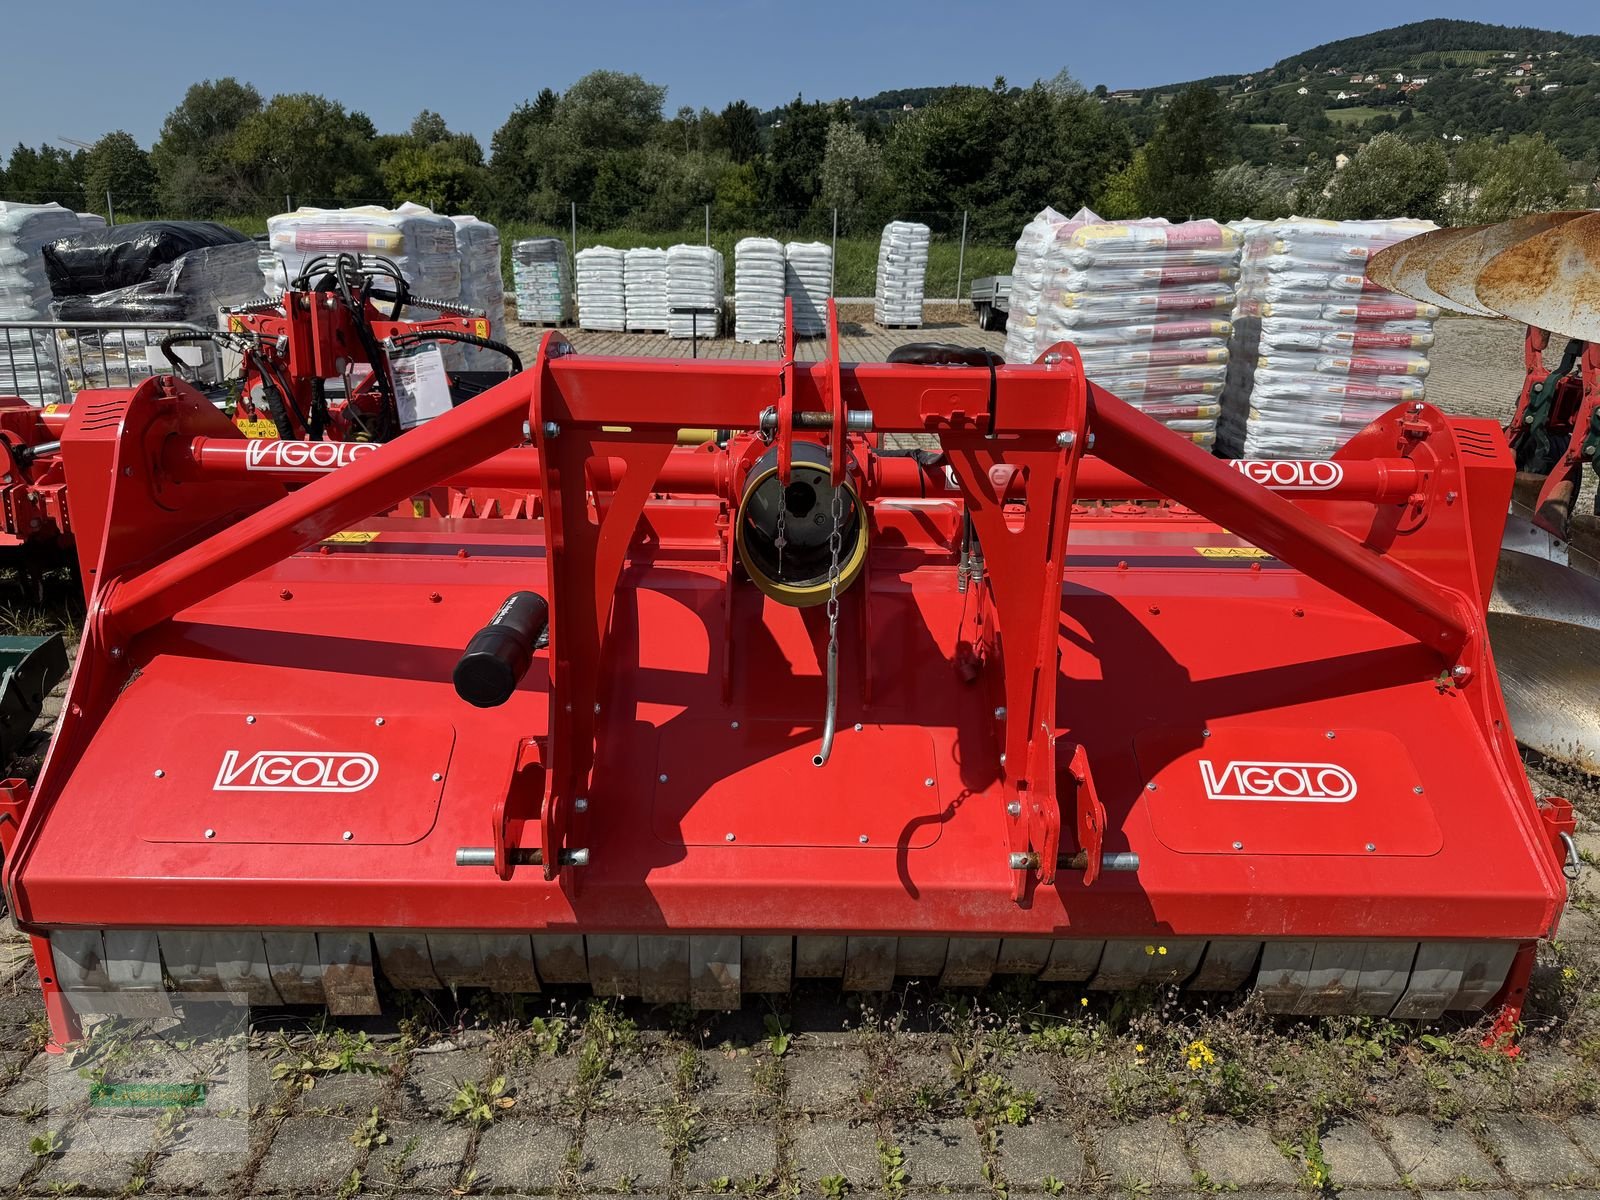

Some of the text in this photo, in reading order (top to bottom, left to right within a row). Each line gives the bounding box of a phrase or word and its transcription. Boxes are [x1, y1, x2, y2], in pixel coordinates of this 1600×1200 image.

[1229, 459, 1343, 490] IGOLO
[213, 750, 379, 793] VIGOLO
[1199, 760, 1358, 803] VIGOLO
